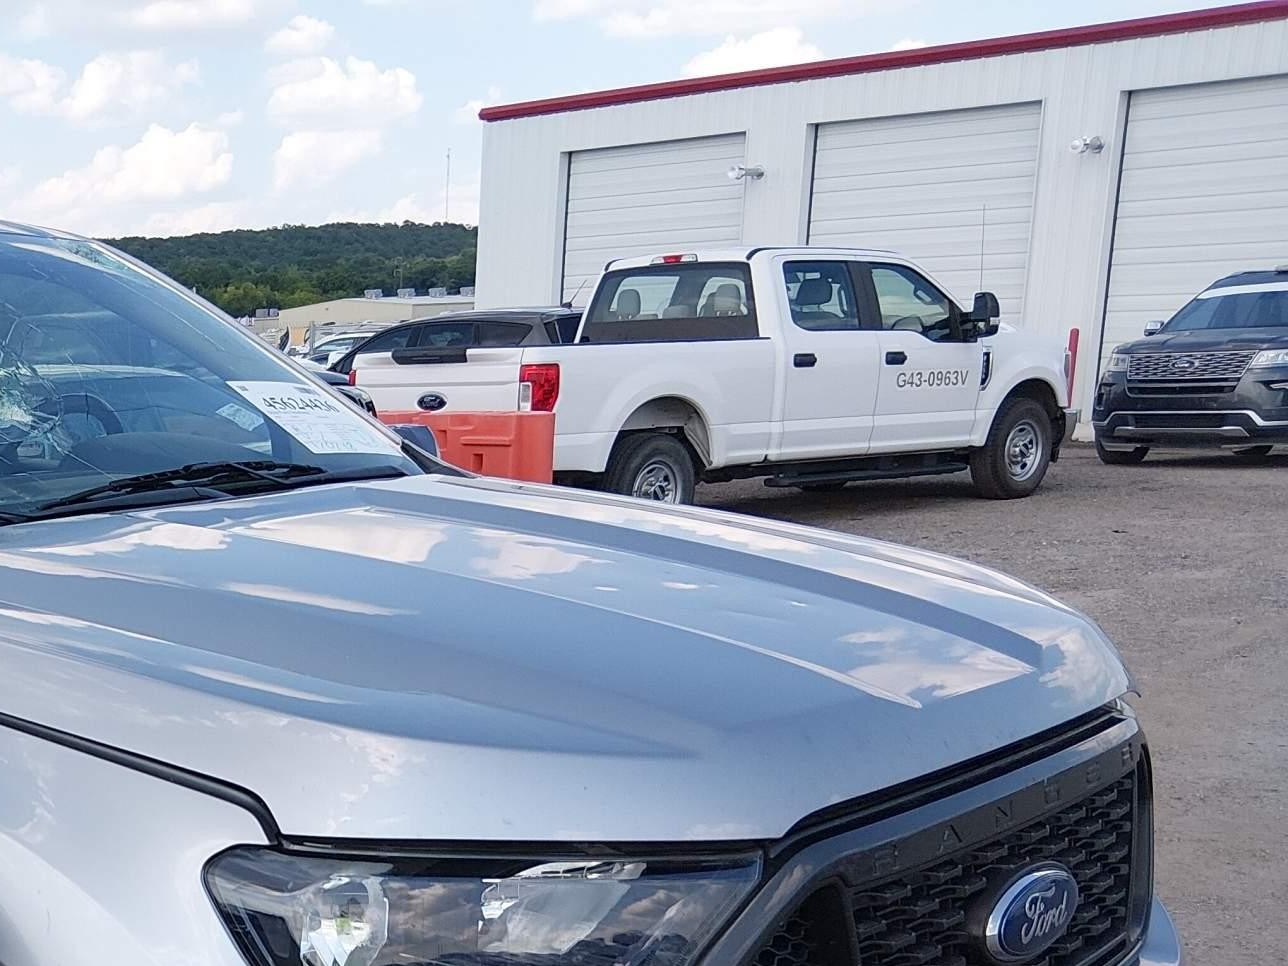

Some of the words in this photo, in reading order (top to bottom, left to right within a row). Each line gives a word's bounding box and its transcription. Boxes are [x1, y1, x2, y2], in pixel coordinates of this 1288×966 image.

[896, 369, 969, 388] G43-0963V
[872, 742, 1134, 874] RANGER
[1021, 885, 1068, 945] Ford
